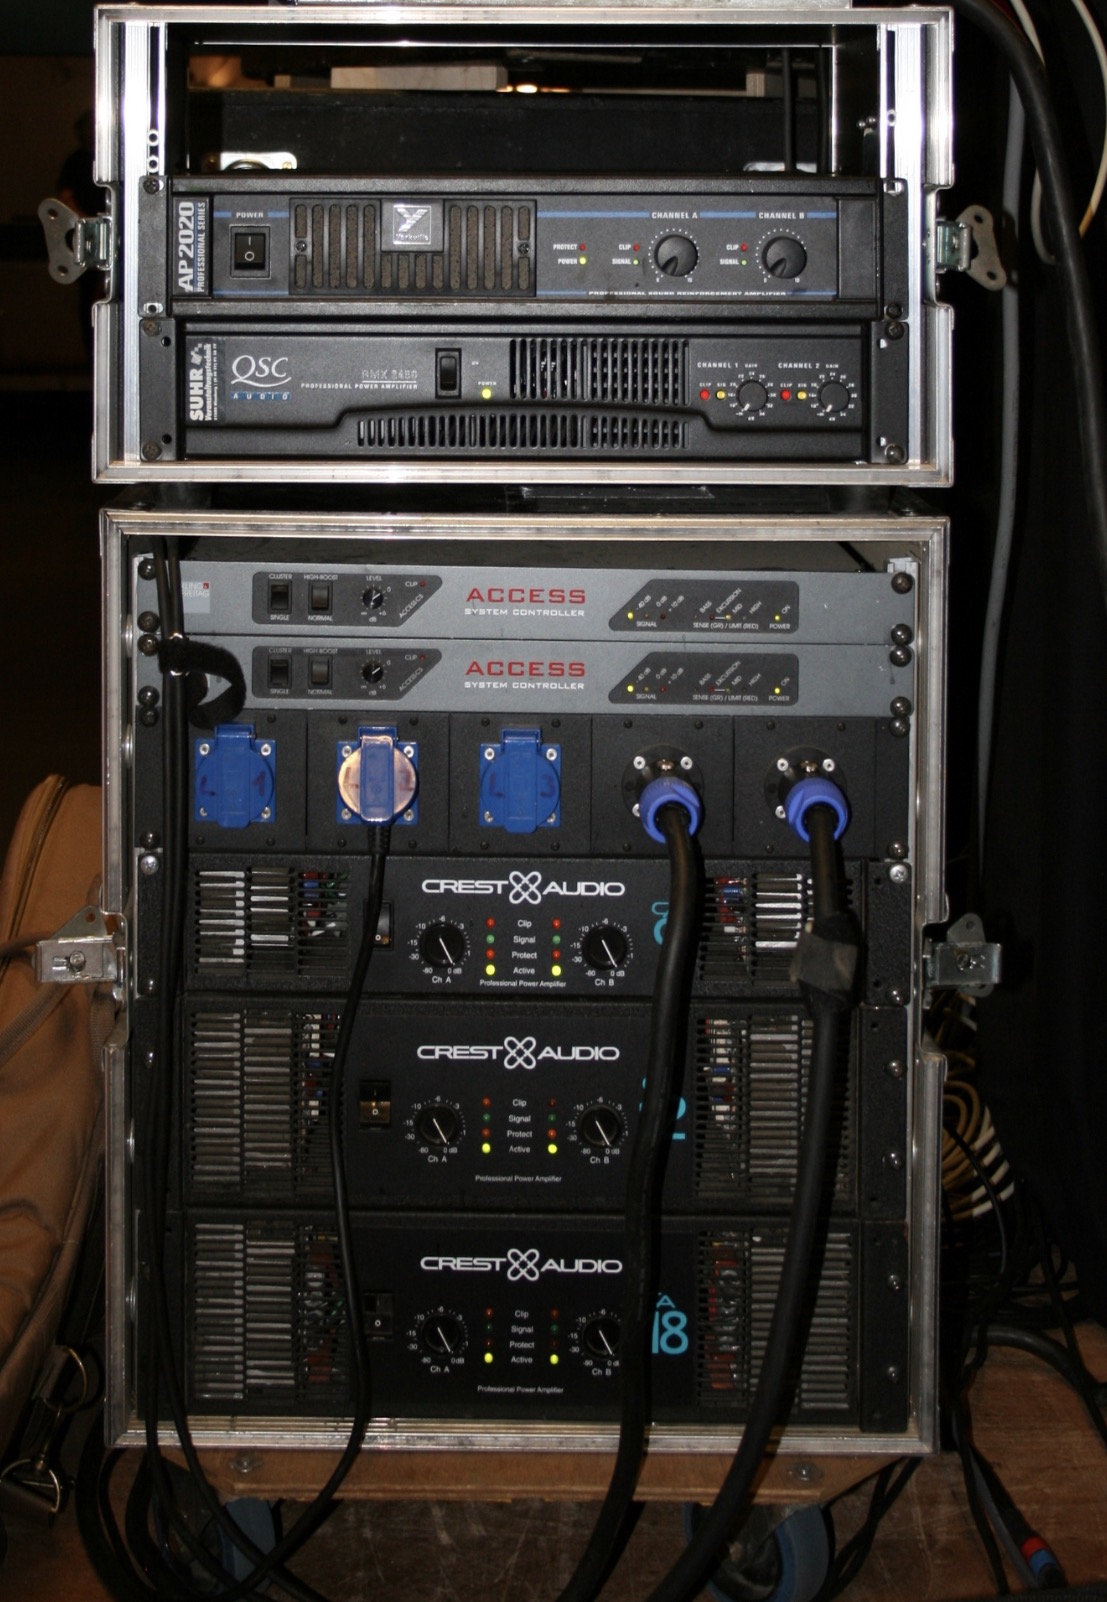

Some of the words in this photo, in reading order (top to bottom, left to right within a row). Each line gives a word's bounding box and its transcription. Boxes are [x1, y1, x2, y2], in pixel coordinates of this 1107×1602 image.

[197, 202, 206, 230] SERIES
[235, 211, 264, 219] POWER
[651, 211, 690, 219] CHANNEL
[691, 211, 698, 219] A
[758, 211, 797, 220] CHANNEL
[798, 211, 806, 220] B
[618, 243, 632, 251] CLIP
[197, 232, 206, 292] PROFESSIONAL
[697, 361, 732, 369] CHANNEL
[231, 355, 292, 387] QSC
[204, 343, 213, 421] Veranstaltungstechnik
[300, 382, 352, 390] PROFESSIONAL
[189, 368, 204, 421] SUHR
[233, 392, 289, 400] AUDIO
[465, 587, 586, 604] ACCESS
[699, 600, 712, 613] BASS
[464, 608, 508, 616] SYSTEM
[512, 609, 585, 617] CONTROLLER
[636, 620, 658, 628] SIGNAL
[465, 661, 586, 677] ACCESS
[464, 681, 508, 689] SYSTEM
[512, 682, 585, 690] CONTROLLER
[421, 879, 509, 894] CREST
[542, 881, 626, 897] AUDIO
[517, 919, 533, 929] Clip
[513, 935, 536, 945] Signal
[570, 941, 581, 949] -15
[511, 951, 537, 960] Protect
[512, 966, 536, 975] Active
[431, 976, 443, 984] Ch
[479, 978, 518, 987] Professional
[518, 980, 539, 988] Power
[539, 980, 567, 989] Amplifier
[594, 978, 606, 987] Ch
[417, 1045, 504, 1060] CREST
[537, 1046, 621, 1061] AUDIO
[512, 1098, 527, 1108] Clip
[508, 1114, 532, 1124] Signal
[506, 1129, 533, 1138] Protect
[508, 1145, 531, 1153] Active
[427, 1154, 439, 1163] Ch
[589, 1155, 601, 1164] Ch
[475, 1173, 514, 1182] Professional
[514, 1174, 534, 1182] Power
[534, 1174, 562, 1184] Amplifier
[420, 1256, 507, 1271] CREST
[540, 1258, 623, 1274] AUDIO
[514, 1309, 530, 1319] Clip
[510, 1325, 534, 1335] Signal
[509, 1340, 535, 1349] Protect
[510, 1355, 533, 1364] Active
[430, 1365, 442, 1374] Ch
[591, 1367, 603, 1376] Ch
[477, 1384, 515, 1393] Professional
[536, 1386, 564, 1395] Amplifier
